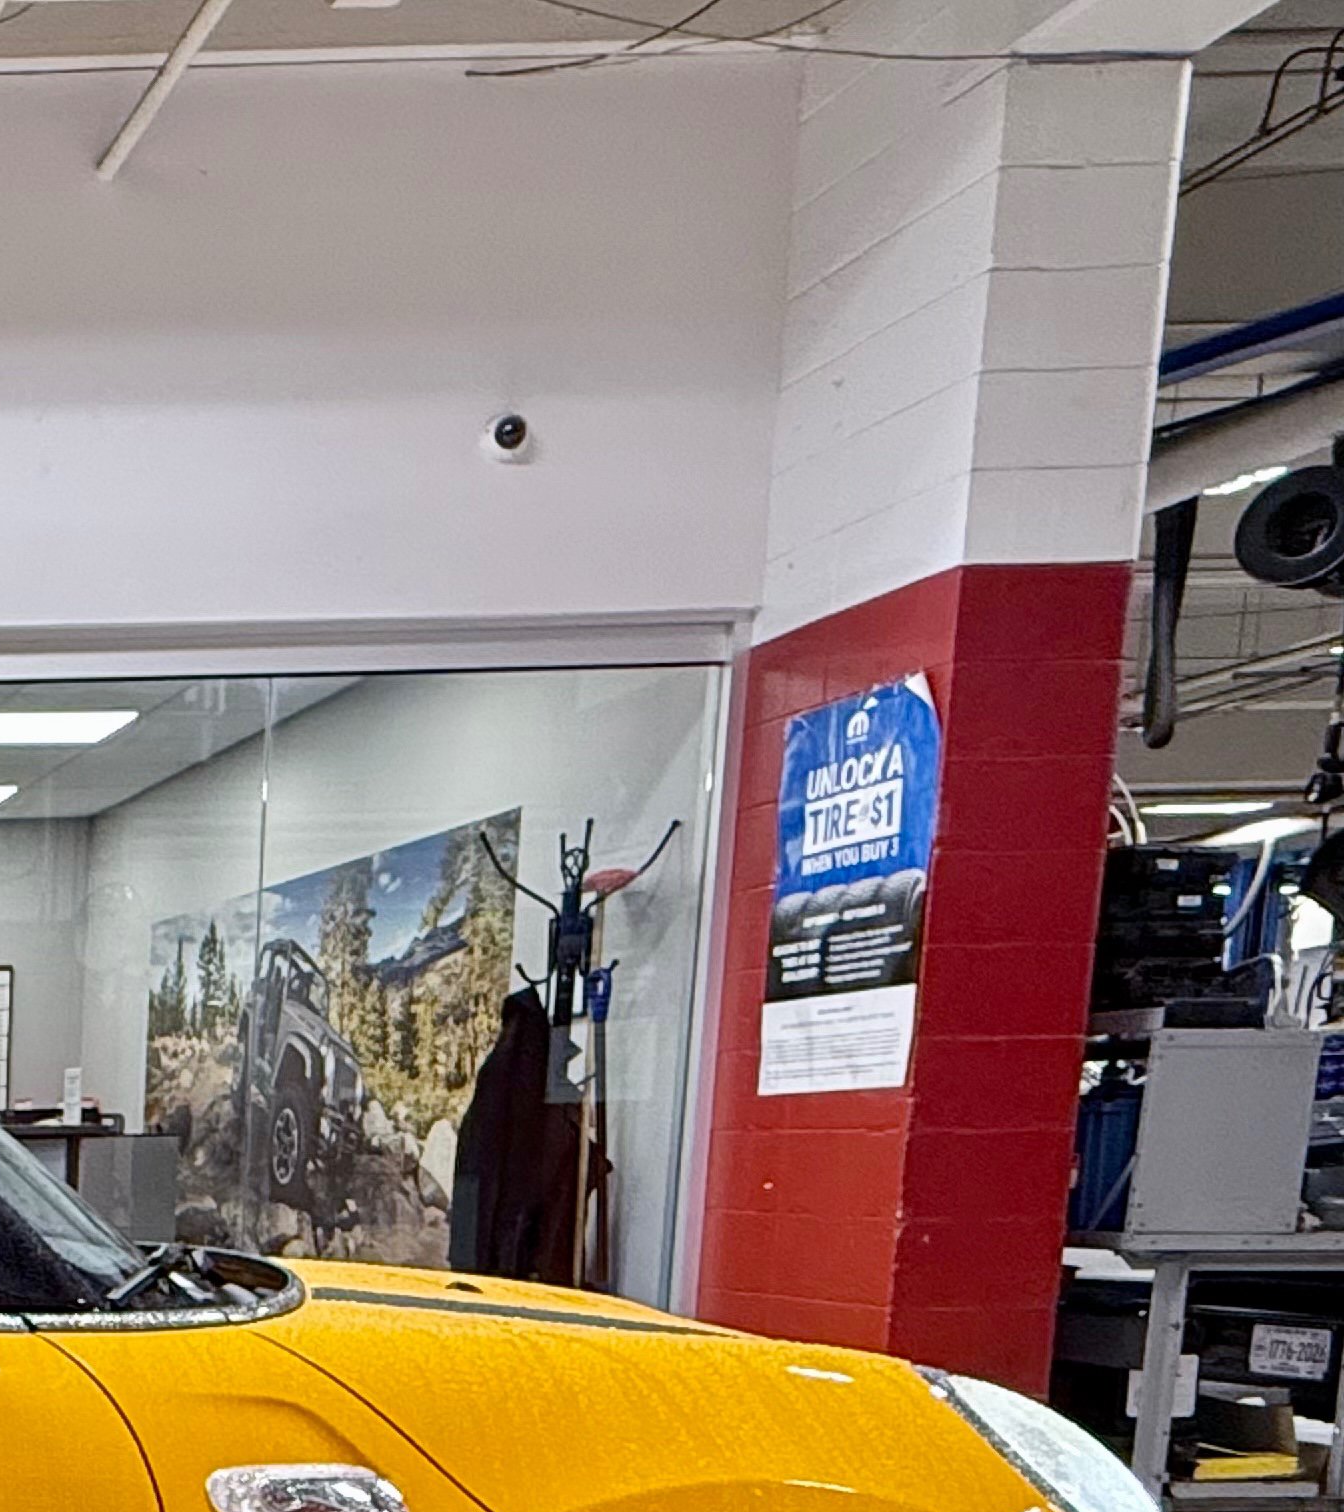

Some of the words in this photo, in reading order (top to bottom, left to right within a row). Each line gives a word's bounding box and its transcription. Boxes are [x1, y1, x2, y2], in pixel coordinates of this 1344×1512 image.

[806, 746, 889, 800] UNLOCK
[886, 744, 903, 776] A
[809, 799, 860, 846] TIRE
[870, 789, 895, 828] $1
[834, 845, 860, 869] YOU
[861, 838, 890, 863] BUY
